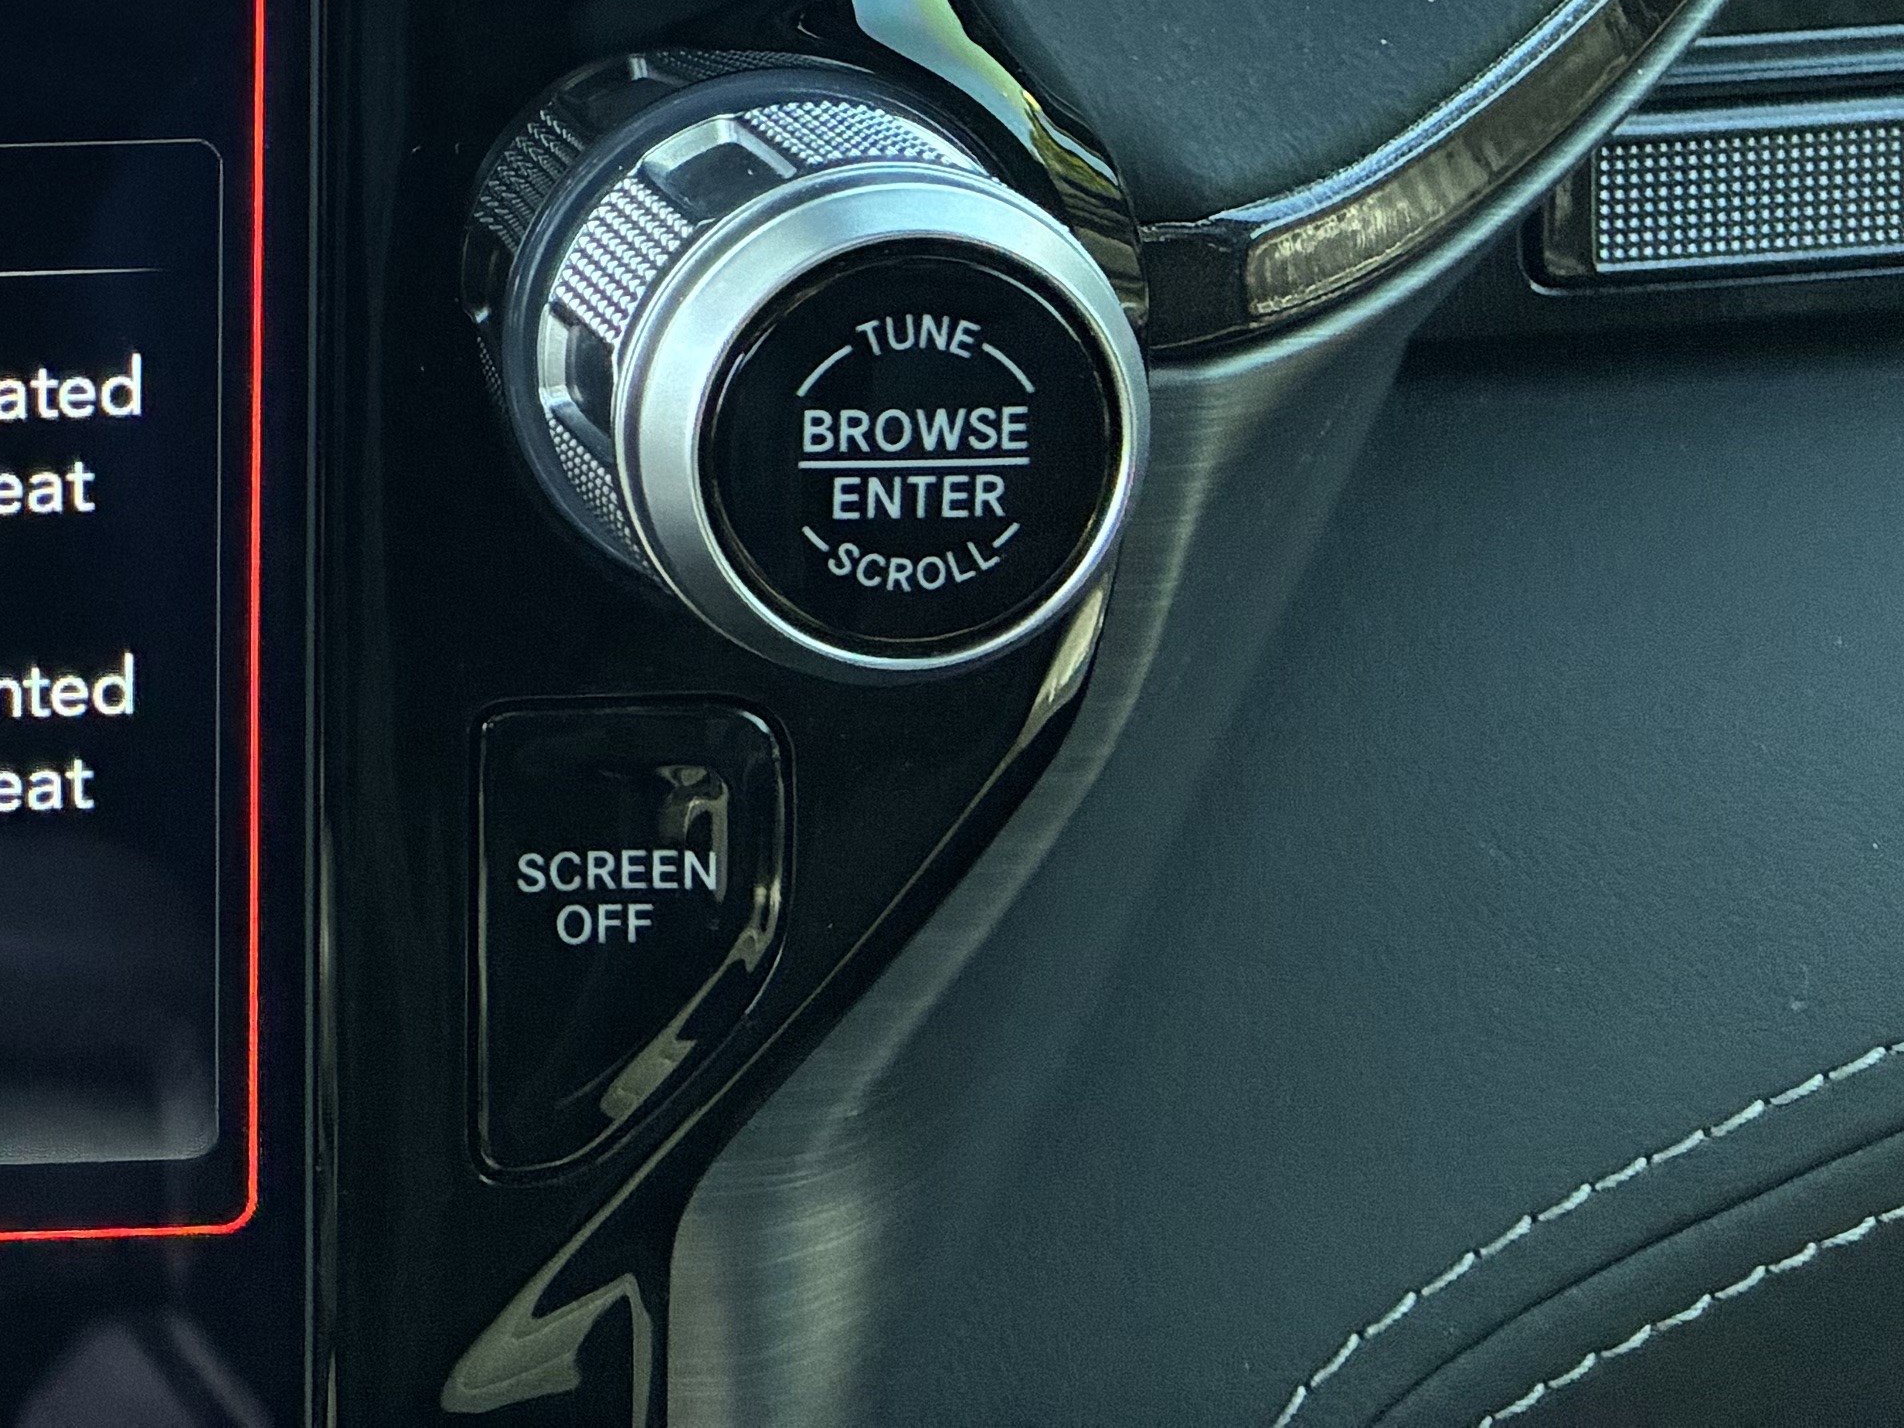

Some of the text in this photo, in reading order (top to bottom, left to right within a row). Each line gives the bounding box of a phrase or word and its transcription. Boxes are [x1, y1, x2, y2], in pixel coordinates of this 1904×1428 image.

[856, 314, 981, 358] TUNE
[803, 406, 1028, 452] BROWSE
[832, 475, 1005, 519] ENTER
[828, 542, 1000, 591] SCROLL
[518, 850, 717, 892] SCREEN
[557, 904, 654, 945] OFF
